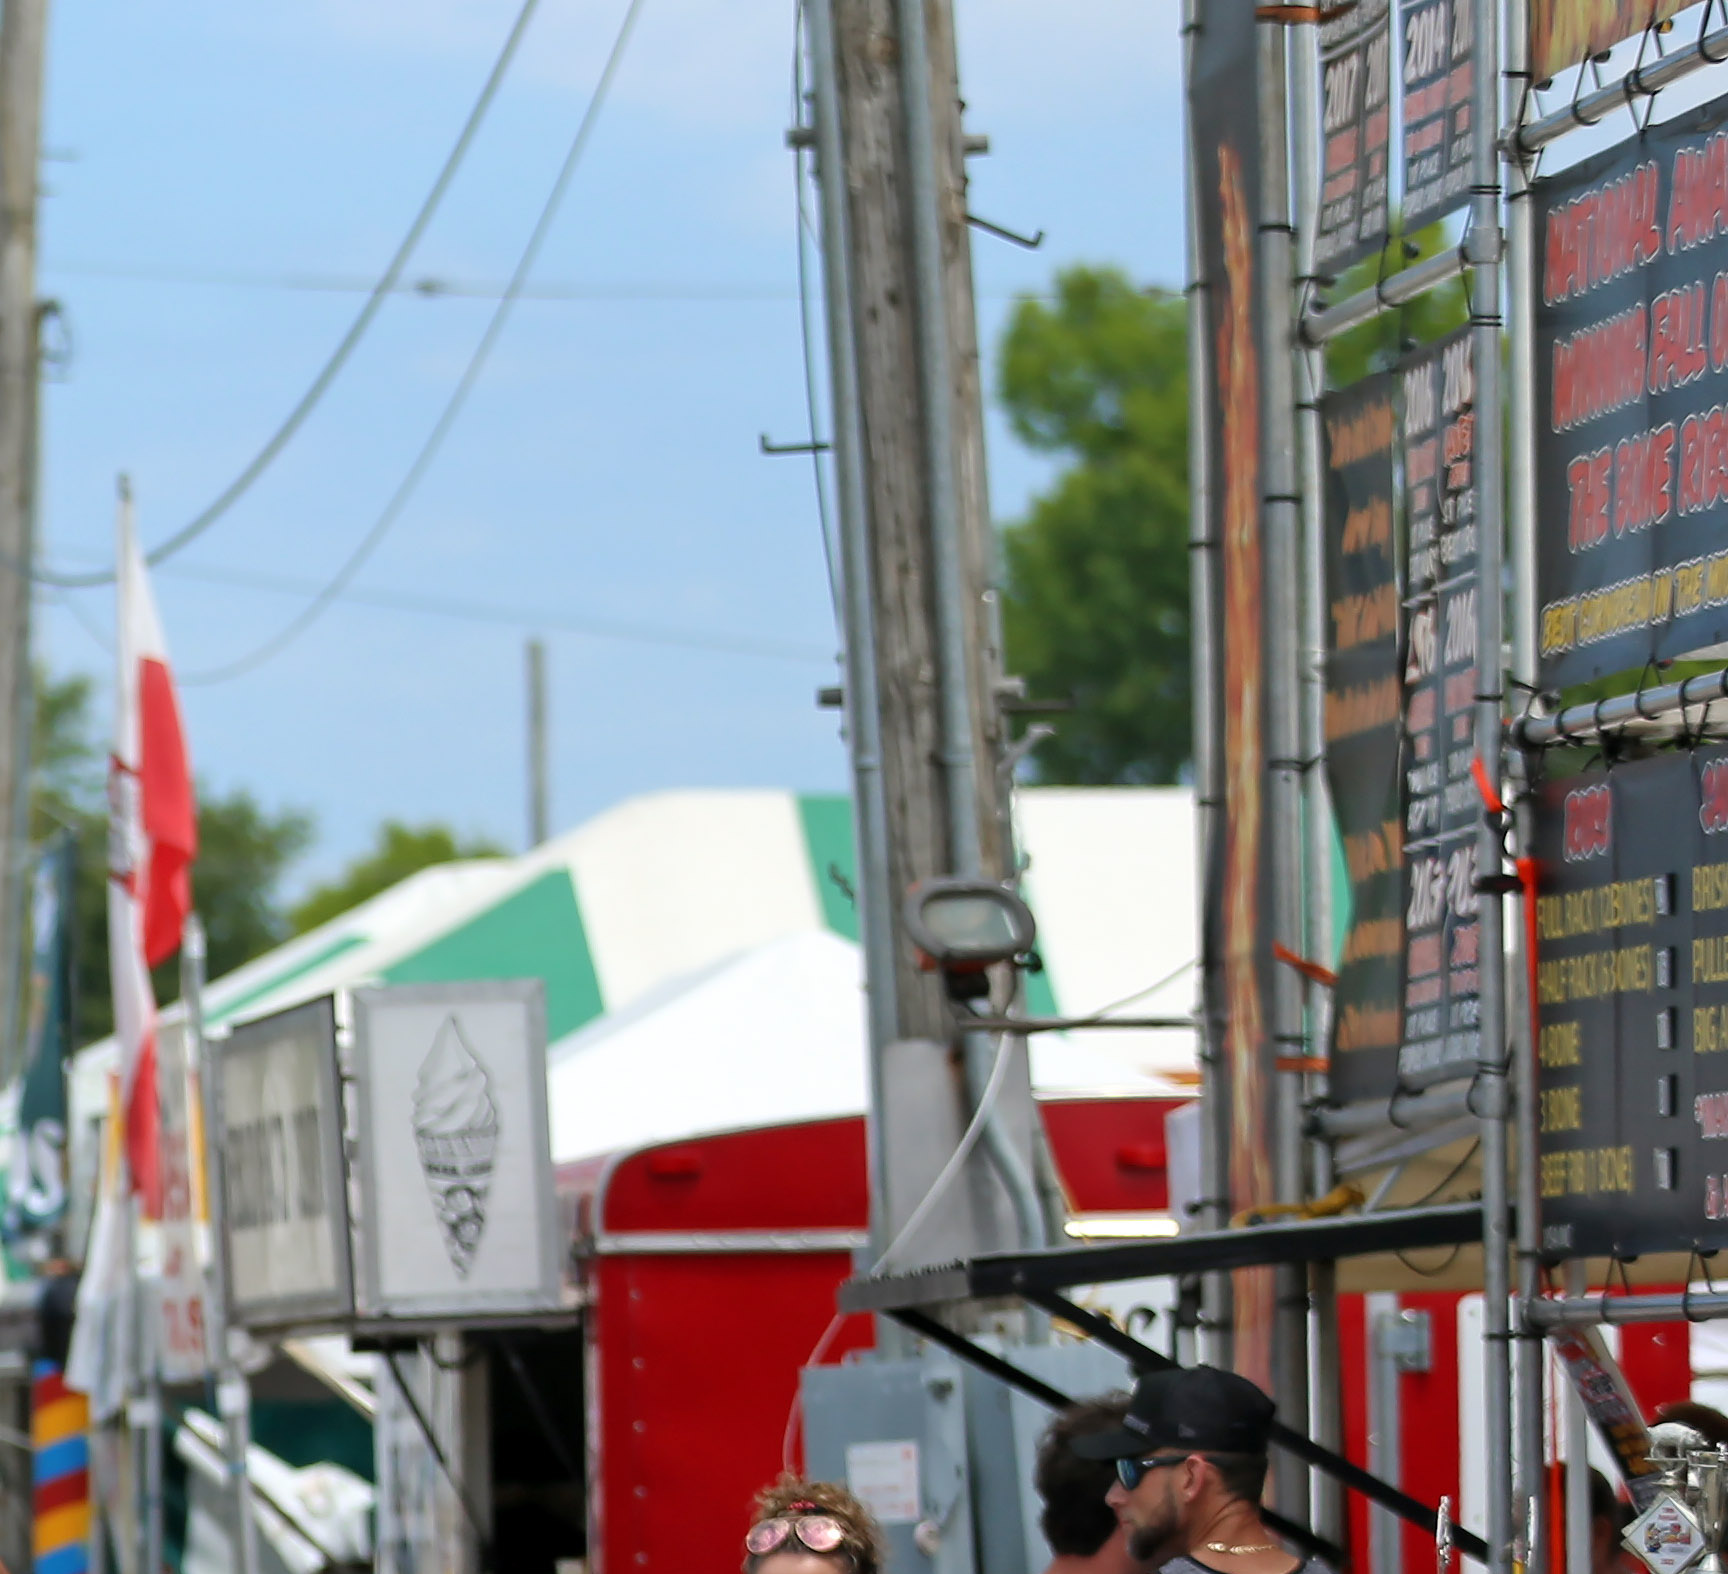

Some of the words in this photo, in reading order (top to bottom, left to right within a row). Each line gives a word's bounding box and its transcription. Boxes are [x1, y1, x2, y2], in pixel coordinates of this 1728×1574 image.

[1544, 159, 1660, 307] NATIONAL
[1666, 132, 1728, 255] AWA
[1647, 282, 1706, 395] FALL
[1567, 446, 1612, 554] THE
[1540, 596, 1578, 658] BEST
[1651, 567, 1673, 625] IN
[1673, 556, 1704, 618] THE
[1693, 862, 1728, 912] BRIS
